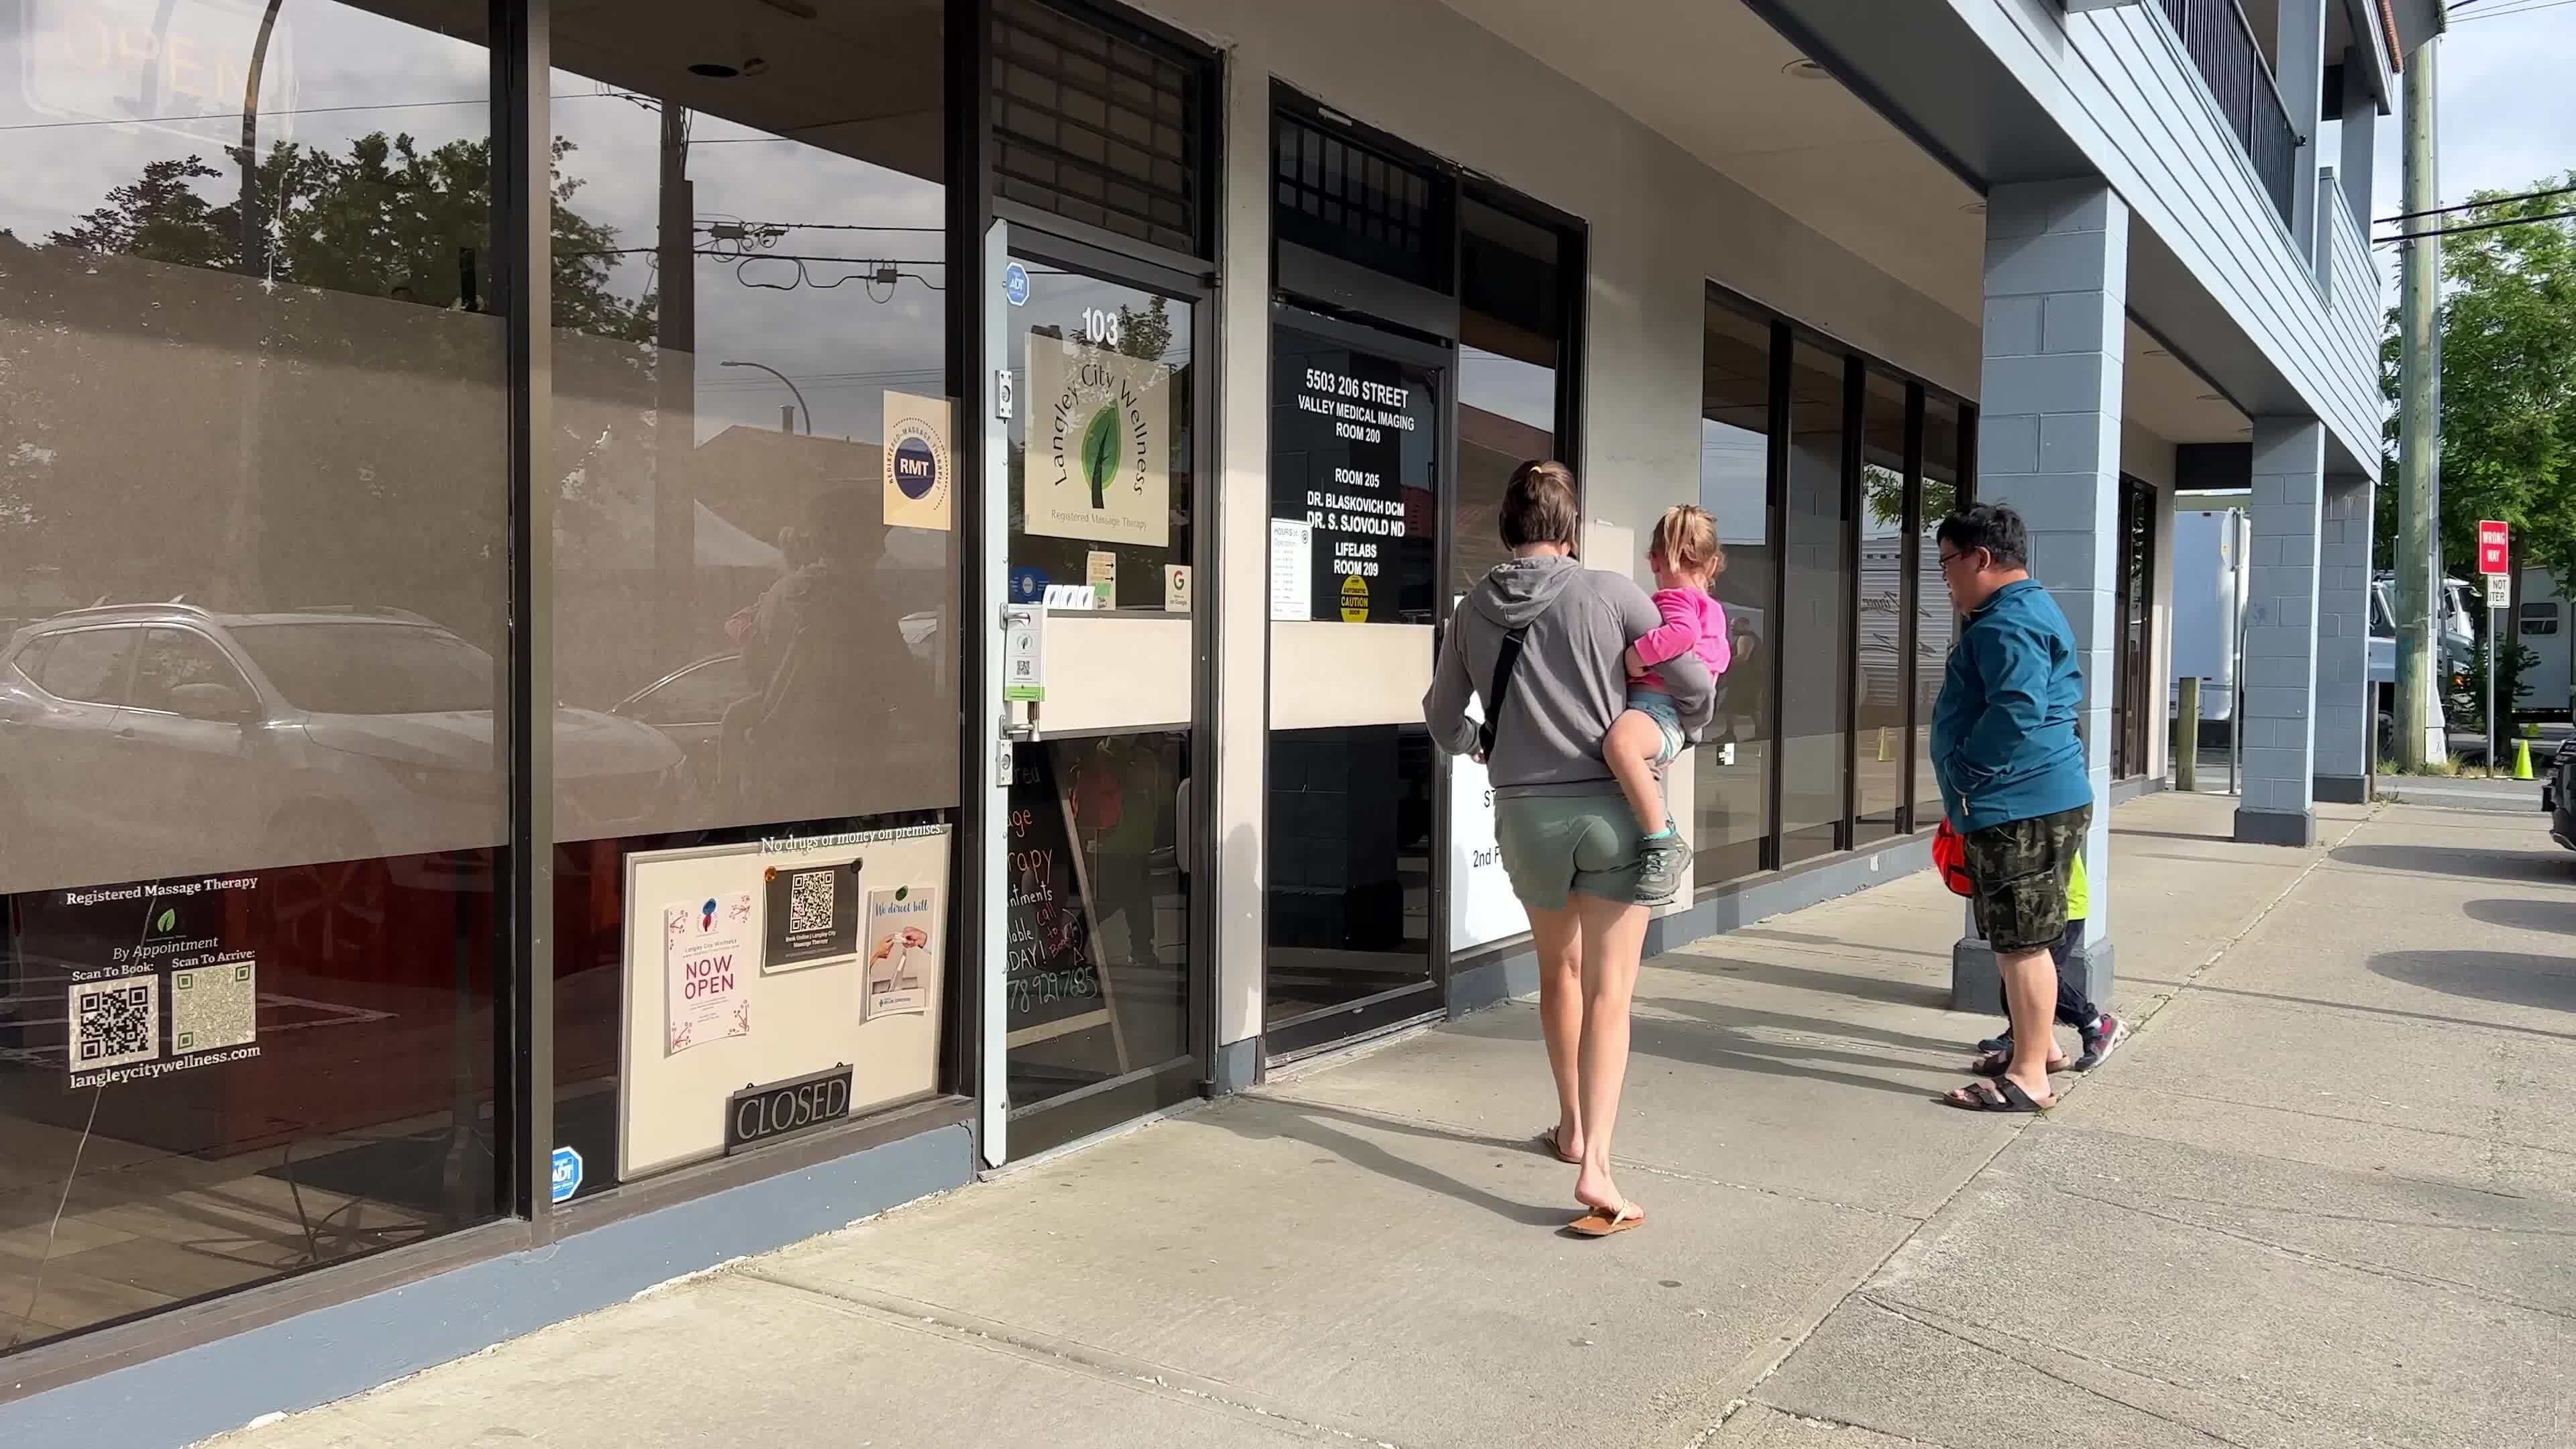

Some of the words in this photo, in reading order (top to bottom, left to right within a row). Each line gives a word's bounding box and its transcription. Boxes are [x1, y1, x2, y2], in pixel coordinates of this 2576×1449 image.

[1010, 277, 1024, 290] ADT
[1082, 306, 1119, 345] 103
[1306, 368, 1335, 393] 5503
[1338, 375, 1359, 398] 206
[1362, 380, 1408, 409] STREET
[1298, 394, 1334, 415] VALLEY
[1336, 402, 1376, 423] MEDICAL
[1378, 413, 1415, 431] IMAGING
[1053, 380, 1079, 486] Langley
[1081, 364, 1114, 394] City
[1121, 379, 1148, 495] Wellness
[1336, 422, 1364, 440] ROOM
[1365, 428, 1381, 443] 200
[900, 458, 929, 476] RMT
[1335, 468, 1362, 486] ROOM
[1364, 473, 1380, 488] 205
[1307, 491, 1324, 507] DR.
[1326, 493, 1383, 515] BLASKOVICH
[1385, 501, 1405, 517] DCM
[1051, 510, 1089, 523] Registered
[1307, 511, 1326, 529] DR.
[1328, 513, 1339, 531] S.
[1340, 515, 1388, 536] SJOVOLD
[1391, 521, 1405, 537] ND
[2483, 531, 2505, 545] WRONG
[1335, 542, 1377, 558] LIFELABS
[2487, 549, 2501, 562] WAY
[1334, 559, 1362, 576] ROOM
[1363, 561, 1379, 577] 209
[2493, 580, 2506, 590] NOT
[1341, 596, 1368, 607] CAUTION
[761, 837, 782, 853] No
[786, 835, 818, 852] drugs
[821, 837, 834, 847] or
[837, 833, 875, 845] money
[878, 829, 893, 840] on
[896, 822, 943, 842] premises.
[1473, 848, 1491, 868] 2nd
[67, 886, 141, 905] Registered
[145, 882, 201, 898] Massage
[205, 877, 258, 892] Therapy
[888, 902, 910, 914] direct
[913, 899, 928, 912] bill
[113, 947, 130, 962] By
[133, 937, 219, 959] Appointment
[172, 957, 199, 969] Scan
[201, 954, 215, 965] To
[217, 950, 255, 963] Arrive:
[72, 970, 101, 982] Scan
[104, 967, 119, 978] To
[121, 962, 154, 977] Book:
[686, 955, 733, 980] NOW
[685, 973, 734, 1000] OPEN
[70, 1045, 262, 1089] langleycitywellness.com
[737, 1078, 847, 1140] CLOSED
